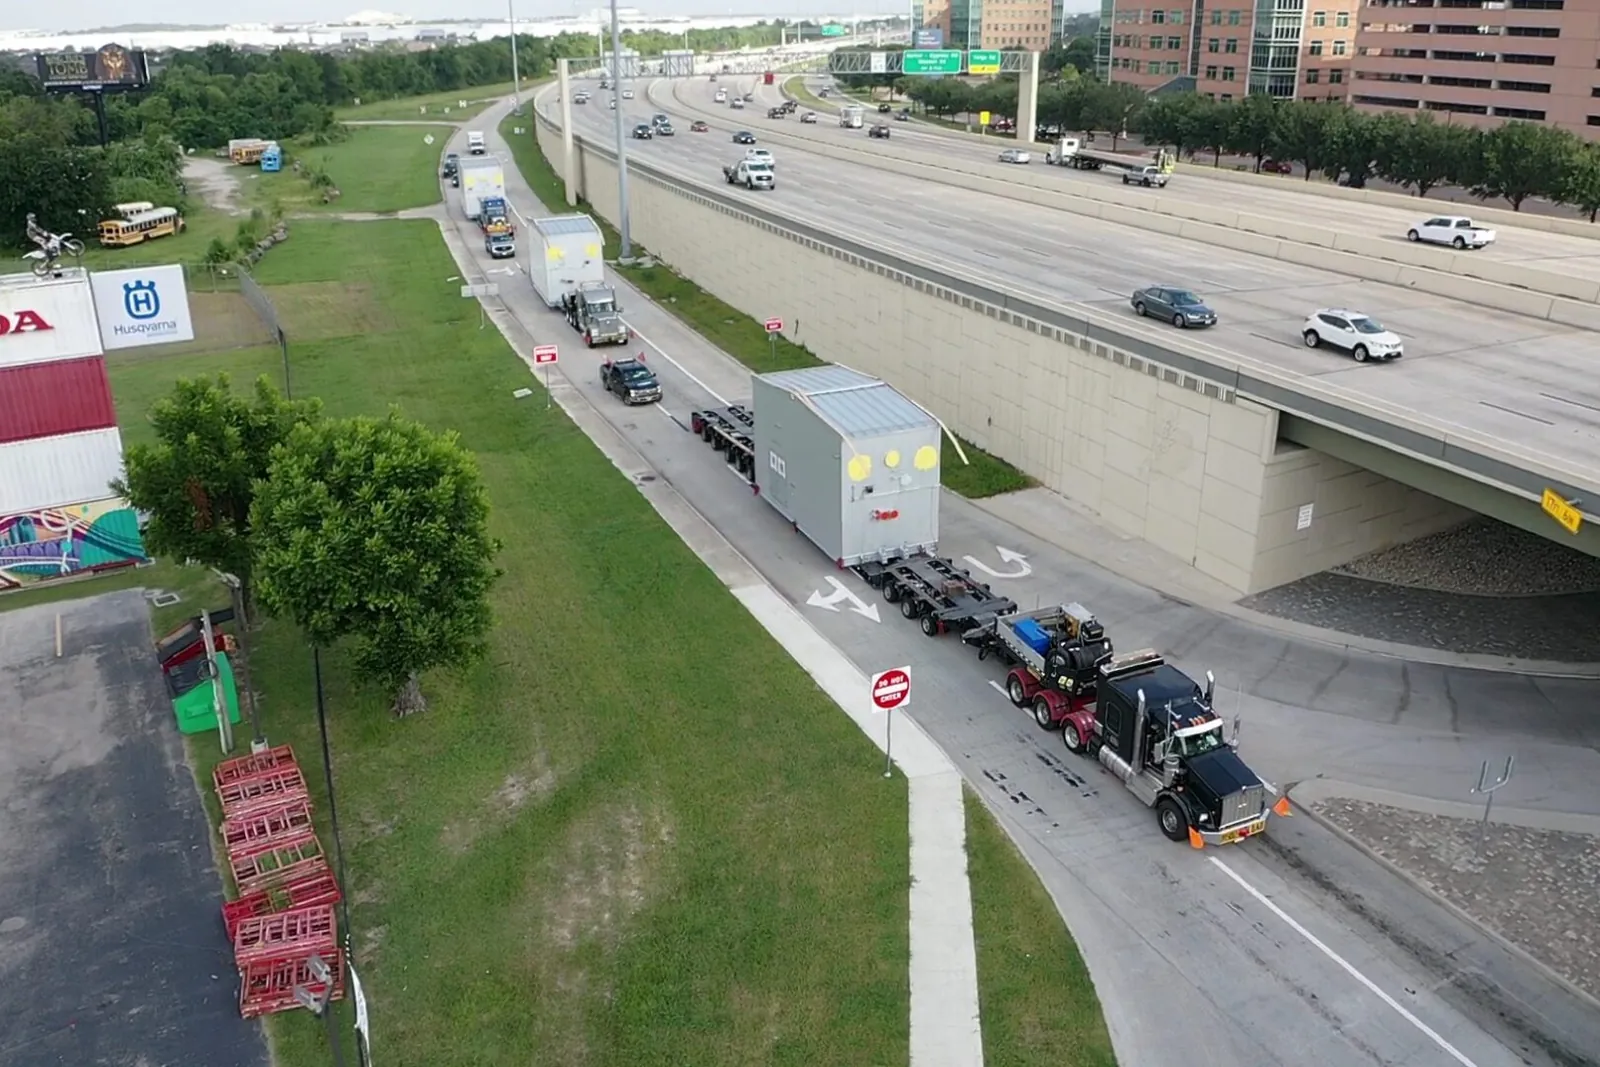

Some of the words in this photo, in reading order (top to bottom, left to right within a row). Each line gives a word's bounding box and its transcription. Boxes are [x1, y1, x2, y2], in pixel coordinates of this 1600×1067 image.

[133, 292, 151, 311] H
[113, 321, 177, 336] Husqvarna
[879, 679, 889, 688] DO
[891, 675, 904, 685] NOT
[880, 692, 902, 703] ENTER
